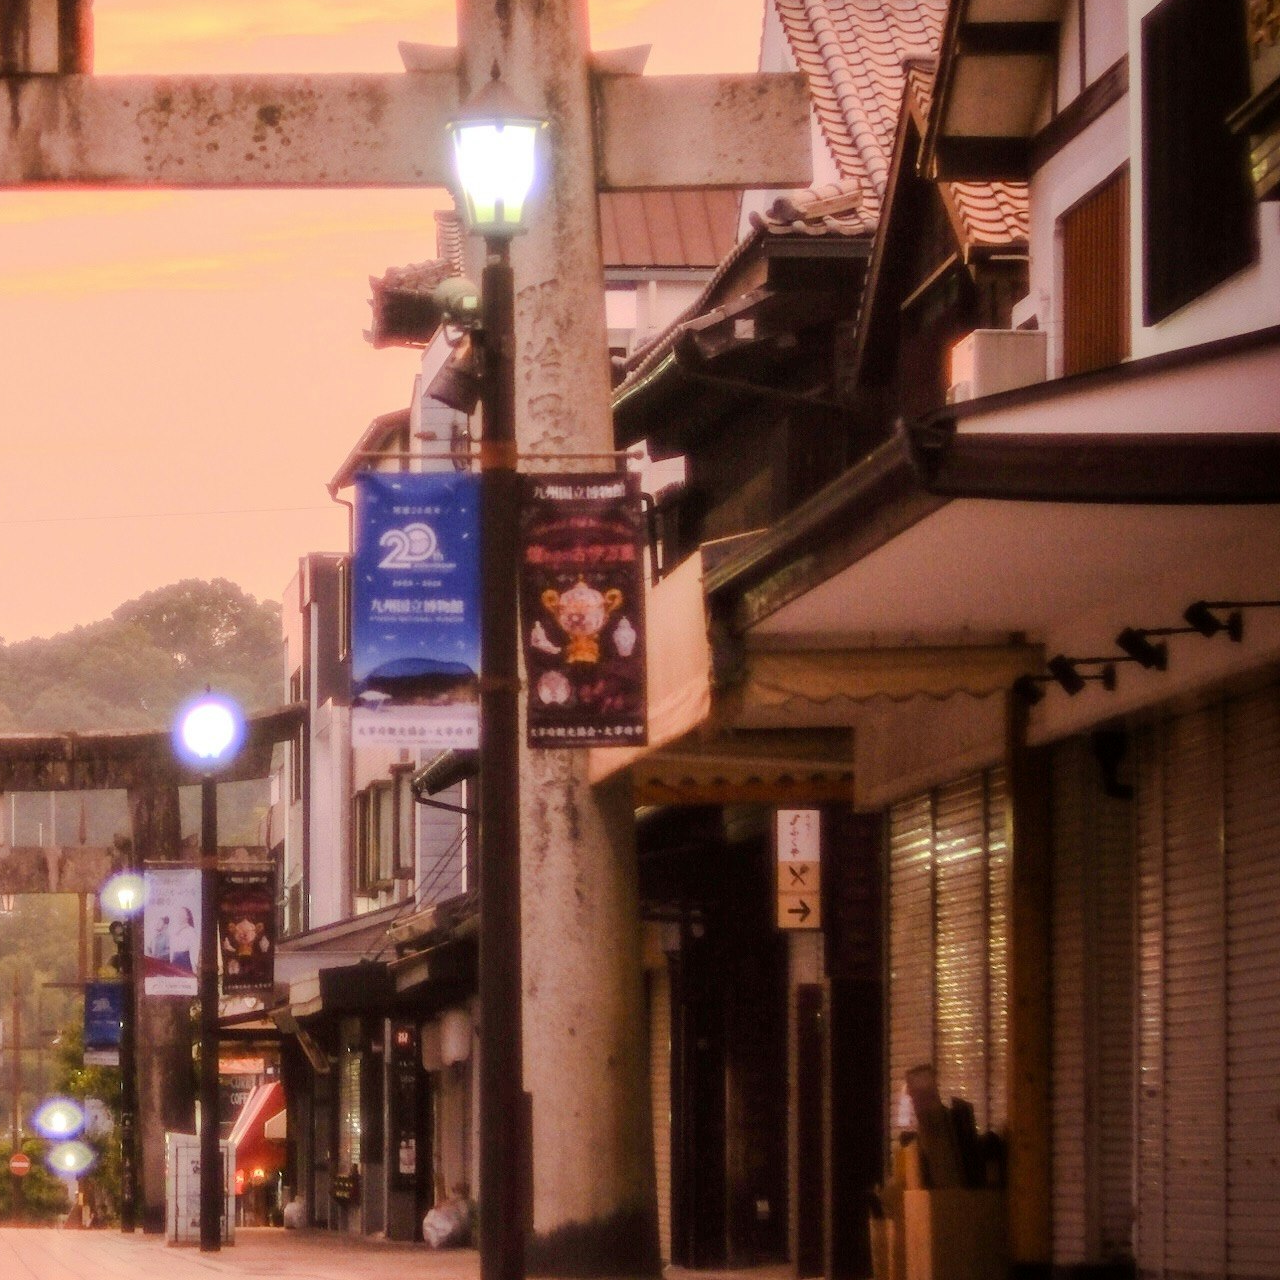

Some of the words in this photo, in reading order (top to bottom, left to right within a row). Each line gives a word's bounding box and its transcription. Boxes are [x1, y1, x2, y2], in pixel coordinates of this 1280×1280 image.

[534, 483, 625, 499] 九州国立博物館
[371, 599, 463, 613] 九州国立博物館
